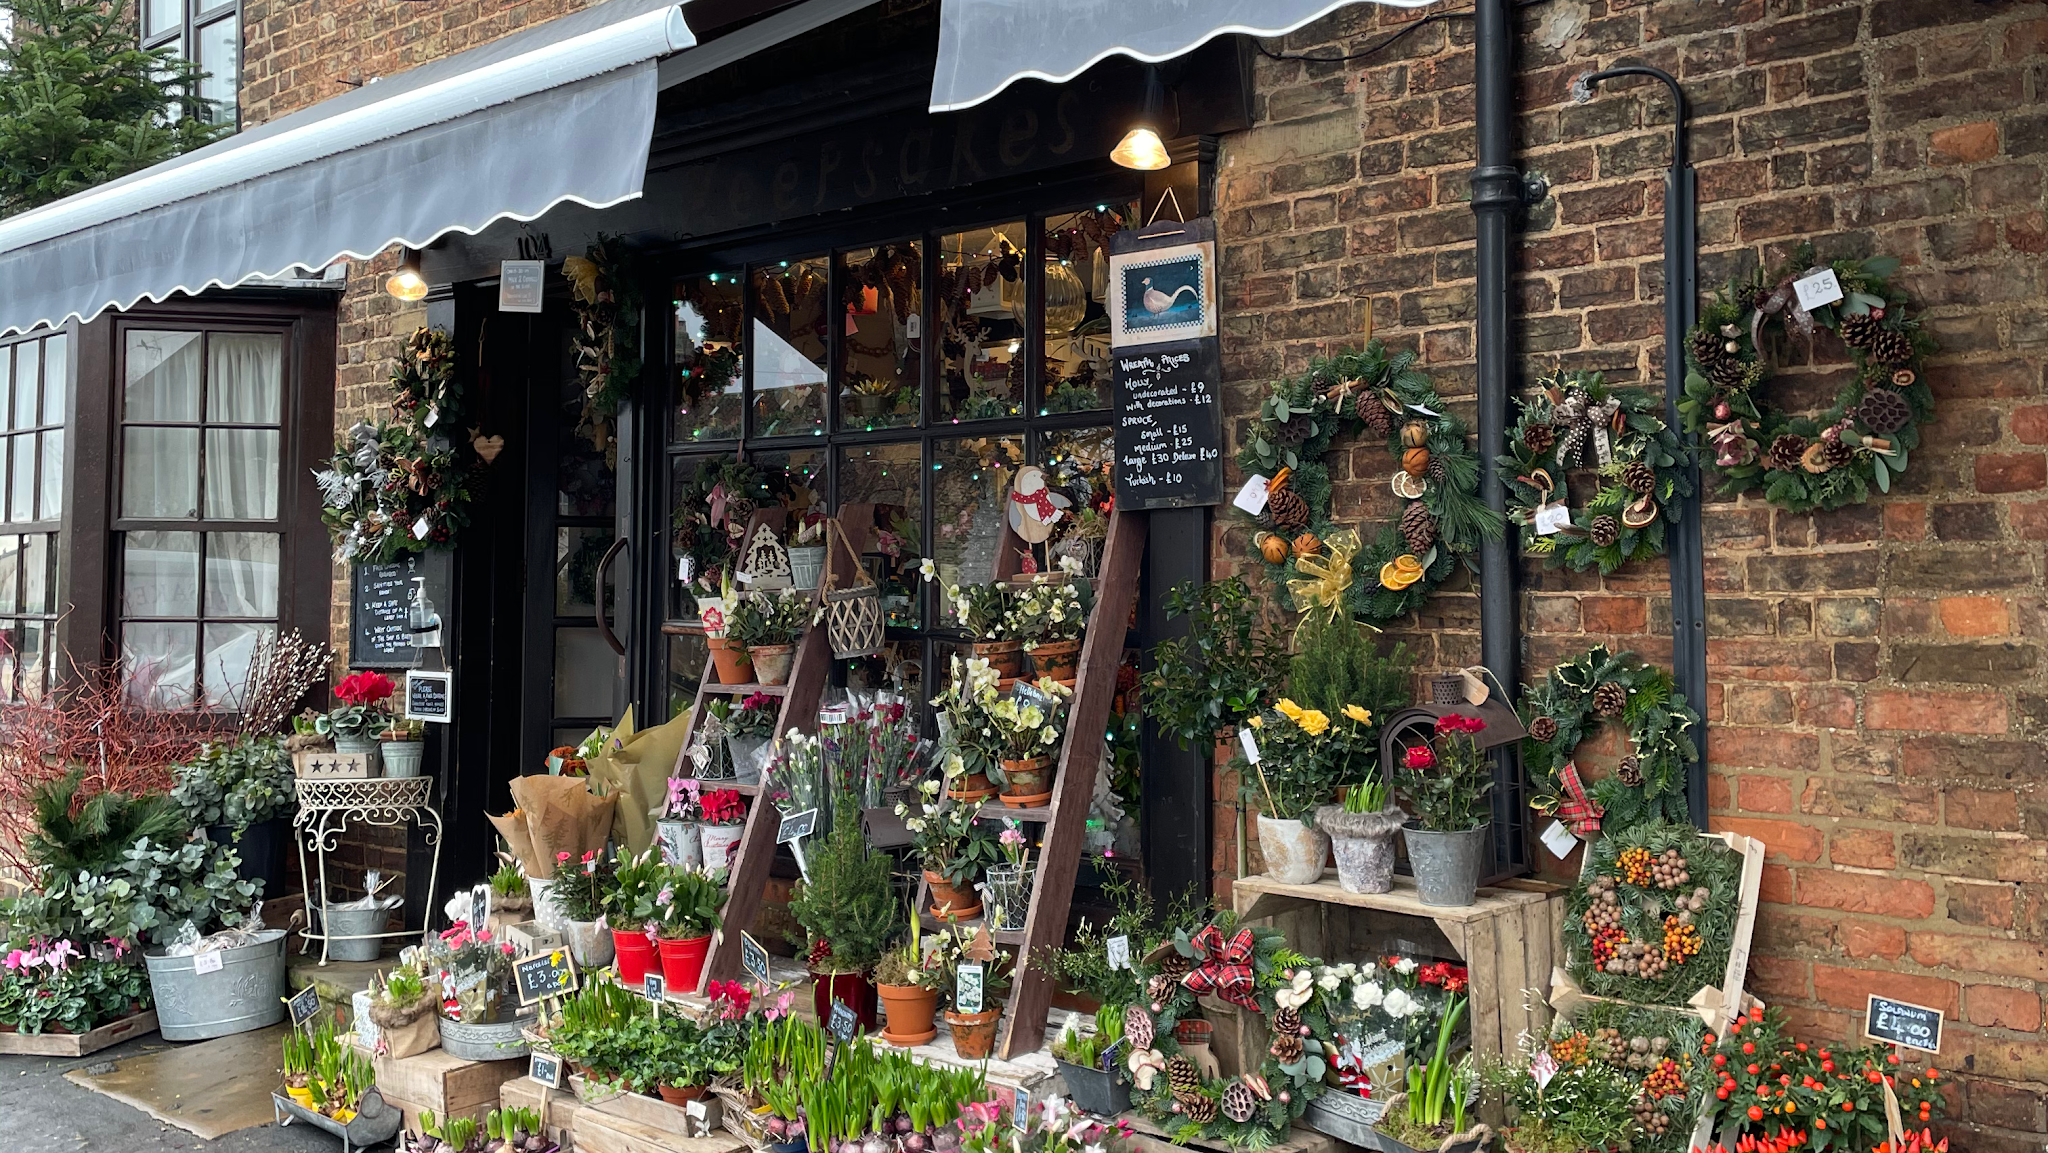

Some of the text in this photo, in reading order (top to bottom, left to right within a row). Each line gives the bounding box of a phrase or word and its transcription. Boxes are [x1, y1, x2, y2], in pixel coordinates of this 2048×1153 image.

[517, 233, 552, 260] 104
[1804, 277, 1833, 300] £25
[1120, 353, 1190, 372] WREATH PRICES
[1132, 384, 1178, 399] undecorated
[1190, 381, 1205, 394] £9
[1125, 400, 1144, 412] with
[1147, 397, 1186, 409] decorations
[1194, 394, 1212, 405] £12
[1140, 427, 1163, 441] small
[1172, 424, 1188, 436] £15
[1134, 442, 1167, 455] medium
[1174, 436, 1193, 450] £25
[1123, 455, 1147, 472] large
[1151, 453, 1169, 465] £30
[1200, 447, 1218, 461] £40
[1125, 473, 1156, 487] Turkish
[1165, 471, 1182, 484] £10
[1876, 1012, 1931, 1038] £4.00
